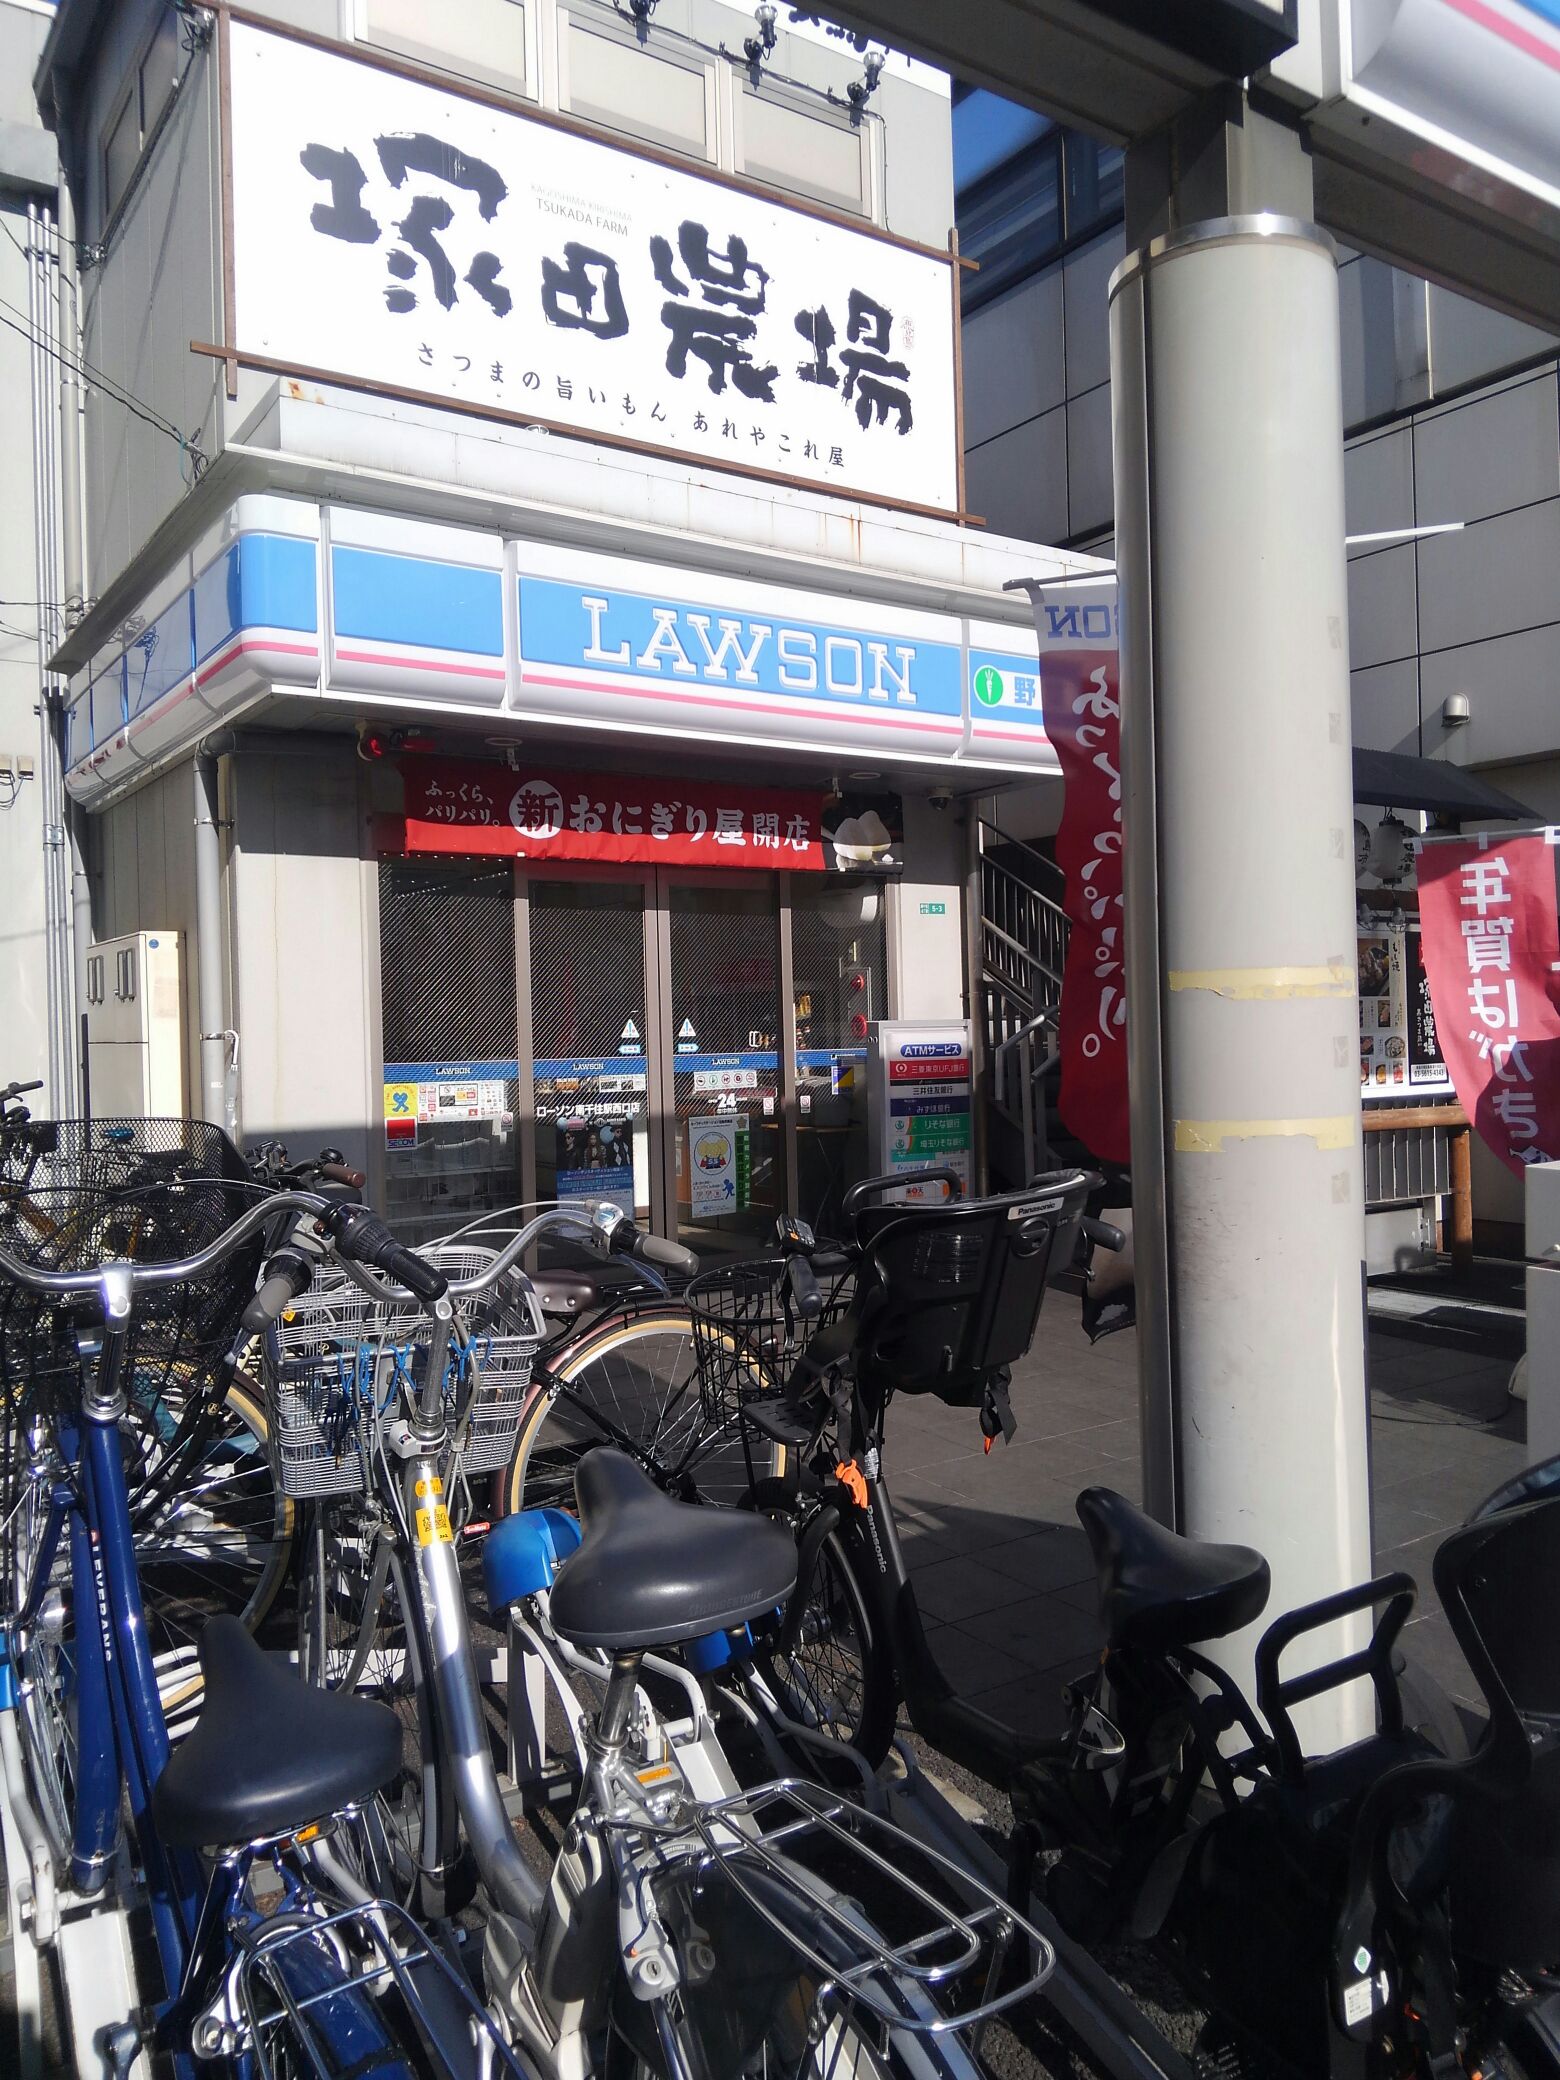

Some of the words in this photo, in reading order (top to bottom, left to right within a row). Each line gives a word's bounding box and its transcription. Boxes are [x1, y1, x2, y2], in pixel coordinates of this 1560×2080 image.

[536, 197, 593, 225] TSUKADA
[595, 216, 629, 237] FARM
[300, 131, 912, 436] 塚田農場
[418, 342, 666, 423] さつまの旨いもん
[693, 410, 844, 468] あれやこれ屋
[581, 596, 917, 704] LAWSON
[425, 780, 494, 804] ふっくら、
[425, 804, 500, 827] パリパリ。
[904, 1044, 959, 1056] ATMサービス
[435, 1067, 471, 1075] LAWSON
[573, 1063, 604, 1071] LAWSON
[911, 1063, 965, 1074] 三菱東京UFJ銀行
[913, 1086, 953, 1096] 三井住友銀行
[718, 1093, 736, 1108] 24
[536, 1102, 640, 1118] ローソン南千住駅西口店
[916, 1104, 951, 1114] みずほ銀行
[924, 1118, 961, 1130] りそな銀行
[1017, 1202, 1056, 1216] Panasonic
[866, 1504, 887, 1573] Panasonic
